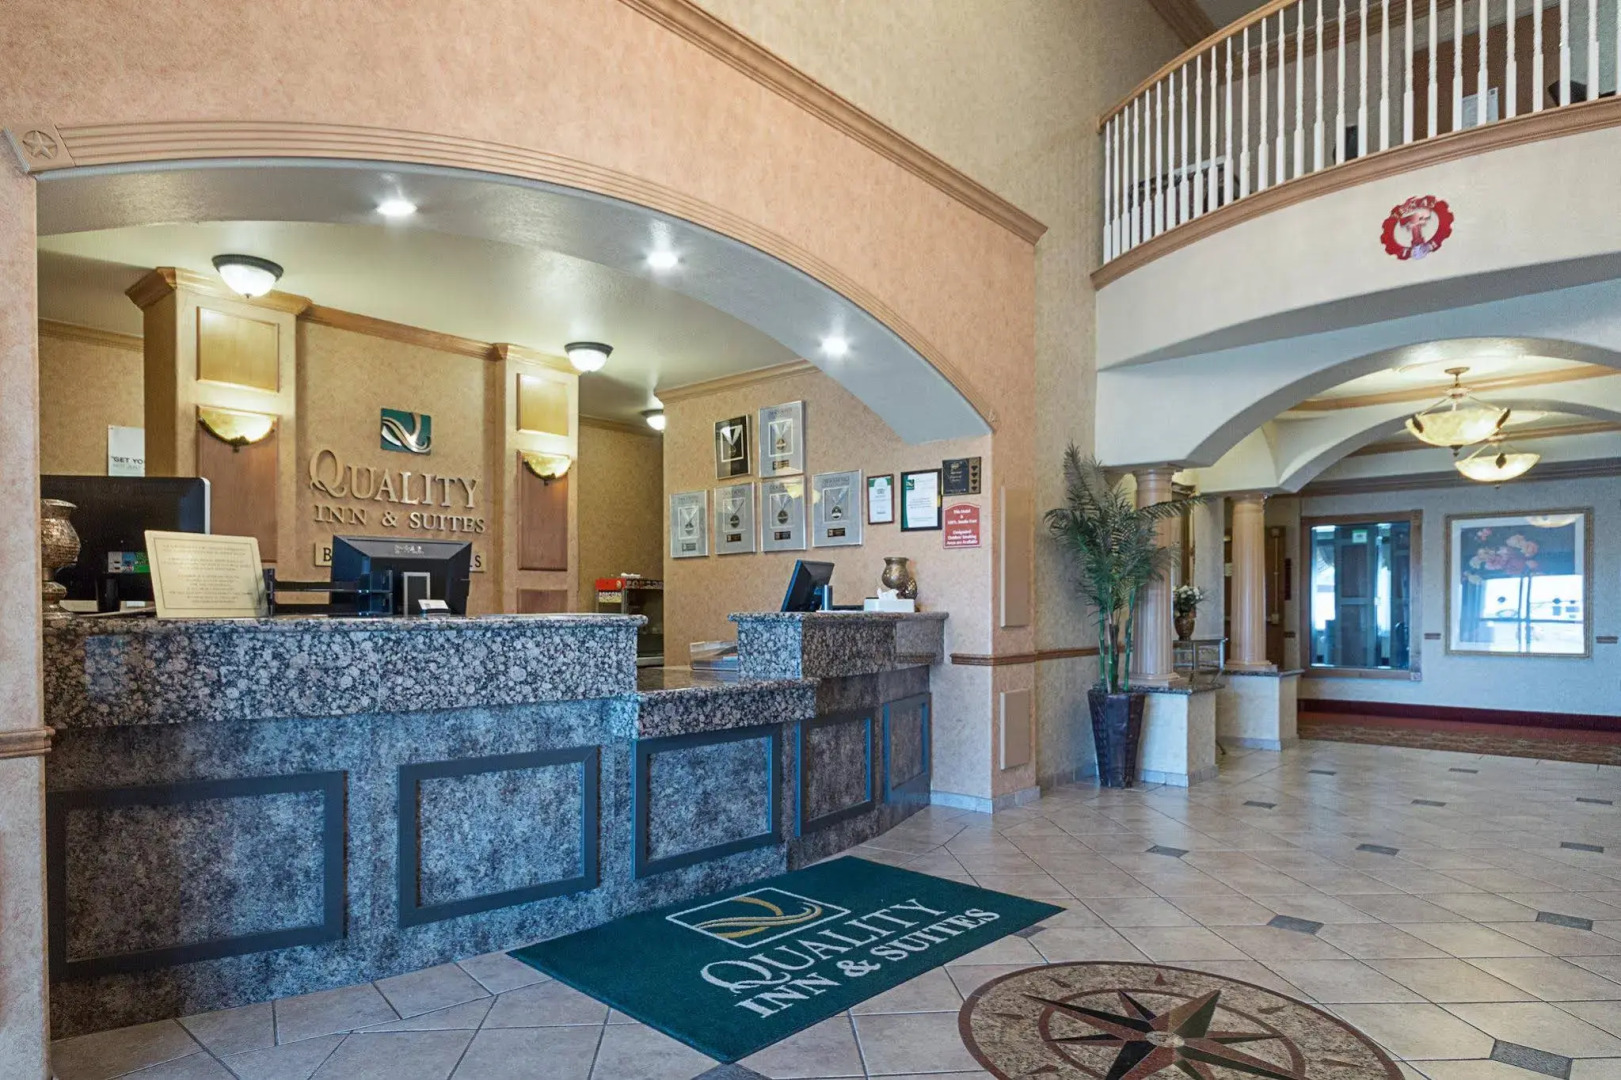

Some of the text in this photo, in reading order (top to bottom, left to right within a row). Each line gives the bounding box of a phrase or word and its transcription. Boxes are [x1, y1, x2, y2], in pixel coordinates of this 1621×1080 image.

[309, 449, 480, 509] QUALITY
[314, 504, 486, 533] INN & SUITES
[700, 898, 947, 994] QUALITY
[734, 908, 1001, 1019] INN & SUITES
